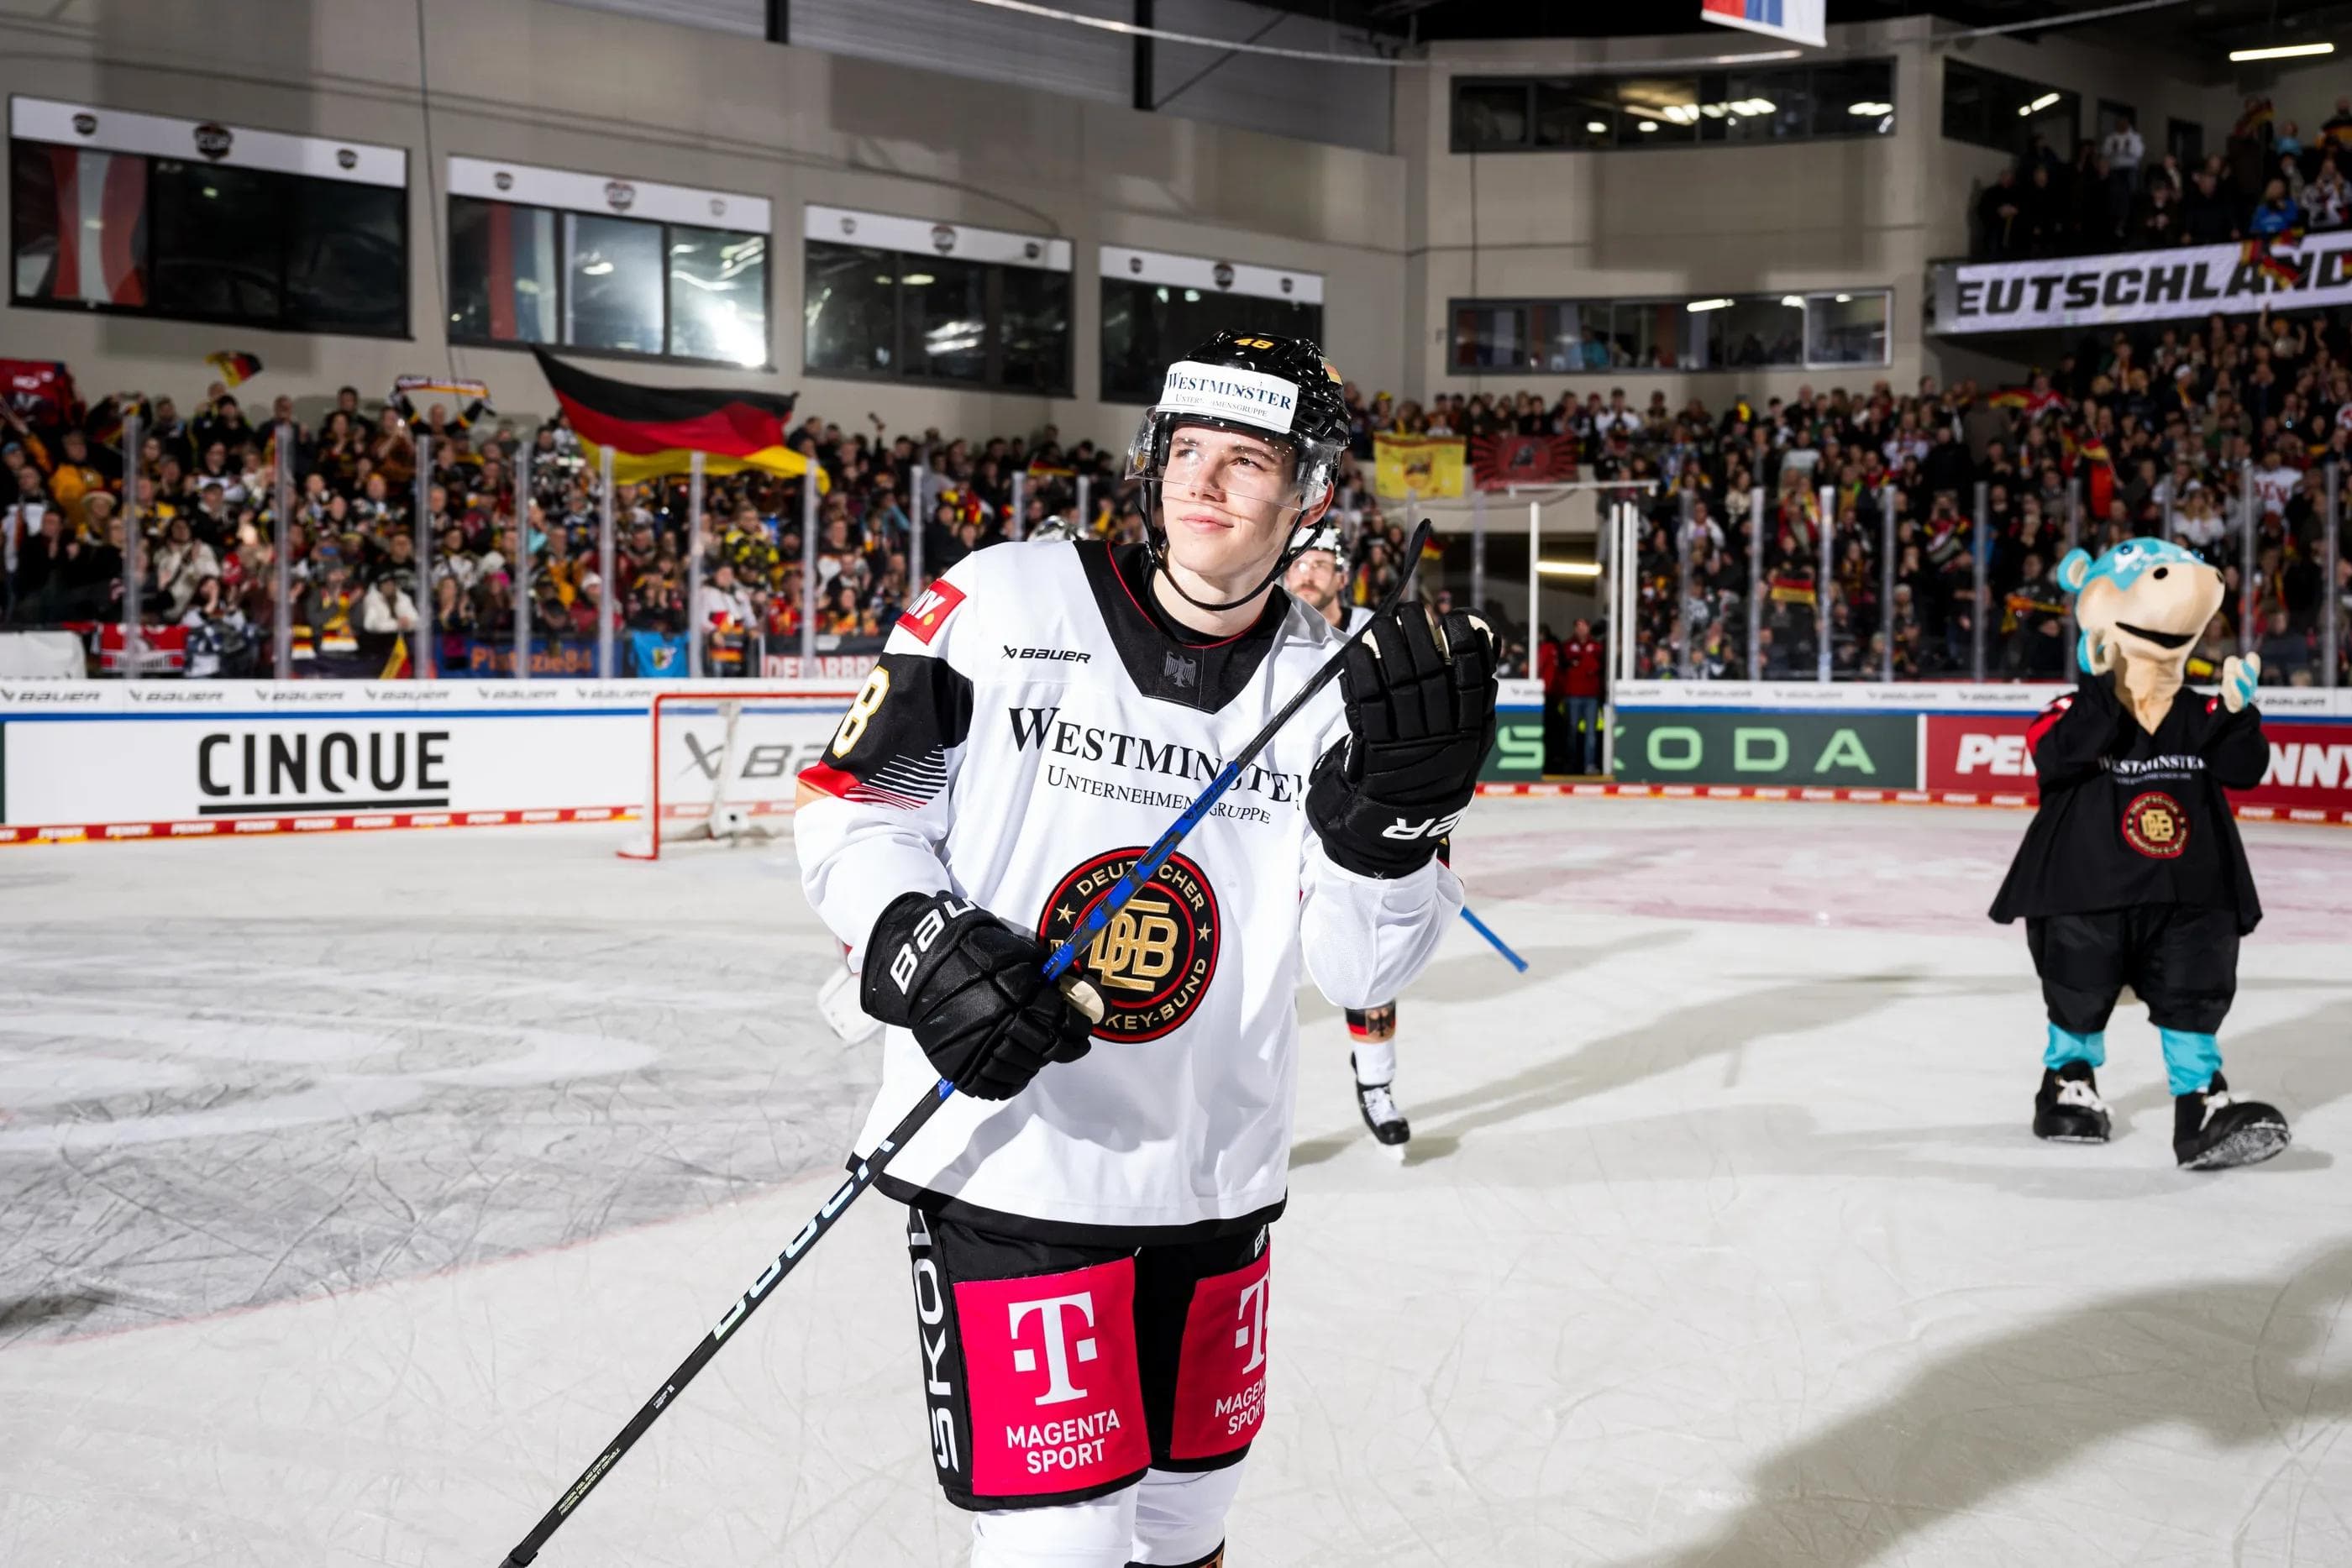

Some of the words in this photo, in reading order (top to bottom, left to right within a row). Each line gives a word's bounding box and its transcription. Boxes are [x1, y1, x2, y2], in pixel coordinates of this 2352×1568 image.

[1168, 373, 1291, 411] WESTMINSTER
[198, 732, 449, 796] CINQUE
[1006, 1408, 1121, 1449] MAGENTA
[1026, 1440, 1106, 1475] SPORT
